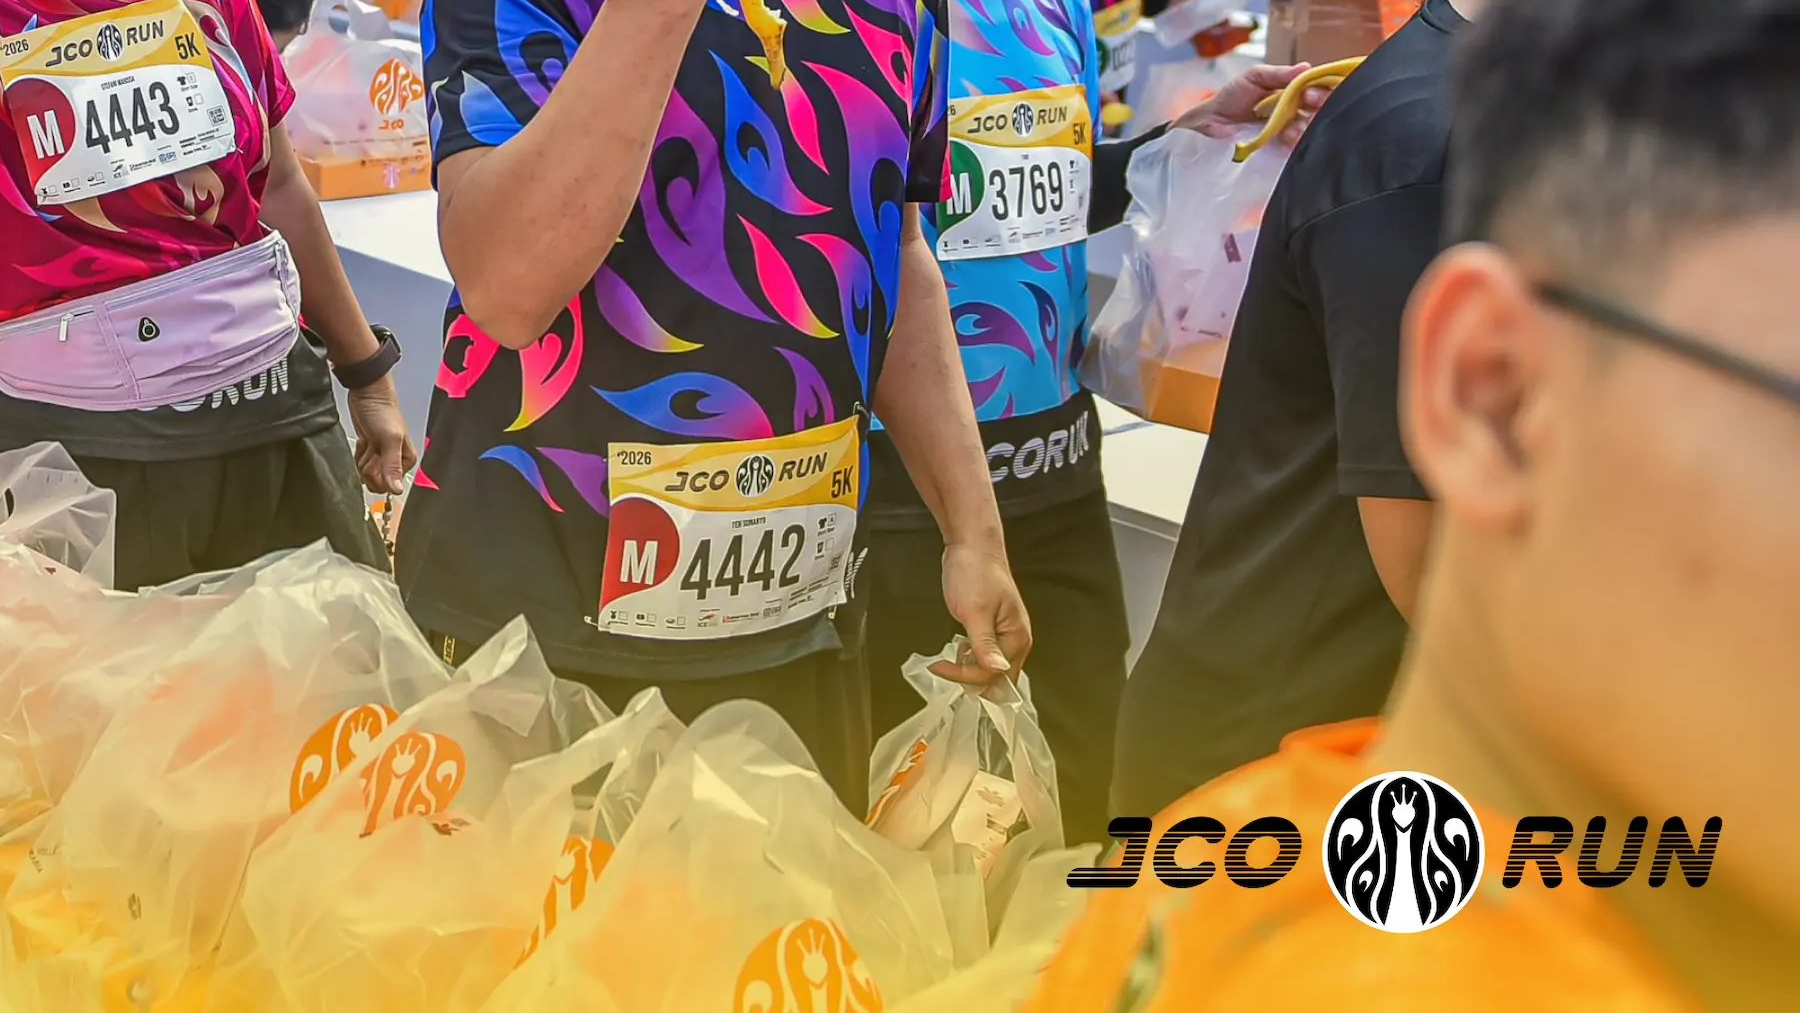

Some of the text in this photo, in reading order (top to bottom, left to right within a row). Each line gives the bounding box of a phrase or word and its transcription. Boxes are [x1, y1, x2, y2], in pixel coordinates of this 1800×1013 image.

[45, 19, 165, 68] JCO RUN
[175, 32, 201, 60] 5K
[27, 109, 65, 159] M
[86, 81, 180, 154] 4443
[967, 106, 1068, 134] JCO RUN
[1073, 122, 1087, 145] 5K
[946, 172, 973, 215] M
[989, 161, 1064, 222] 3769
[665, 452, 828, 493] JCO RUN
[831, 466, 853, 499] 5K
[620, 540, 658, 585] M
[680, 524, 806, 601] 4442
